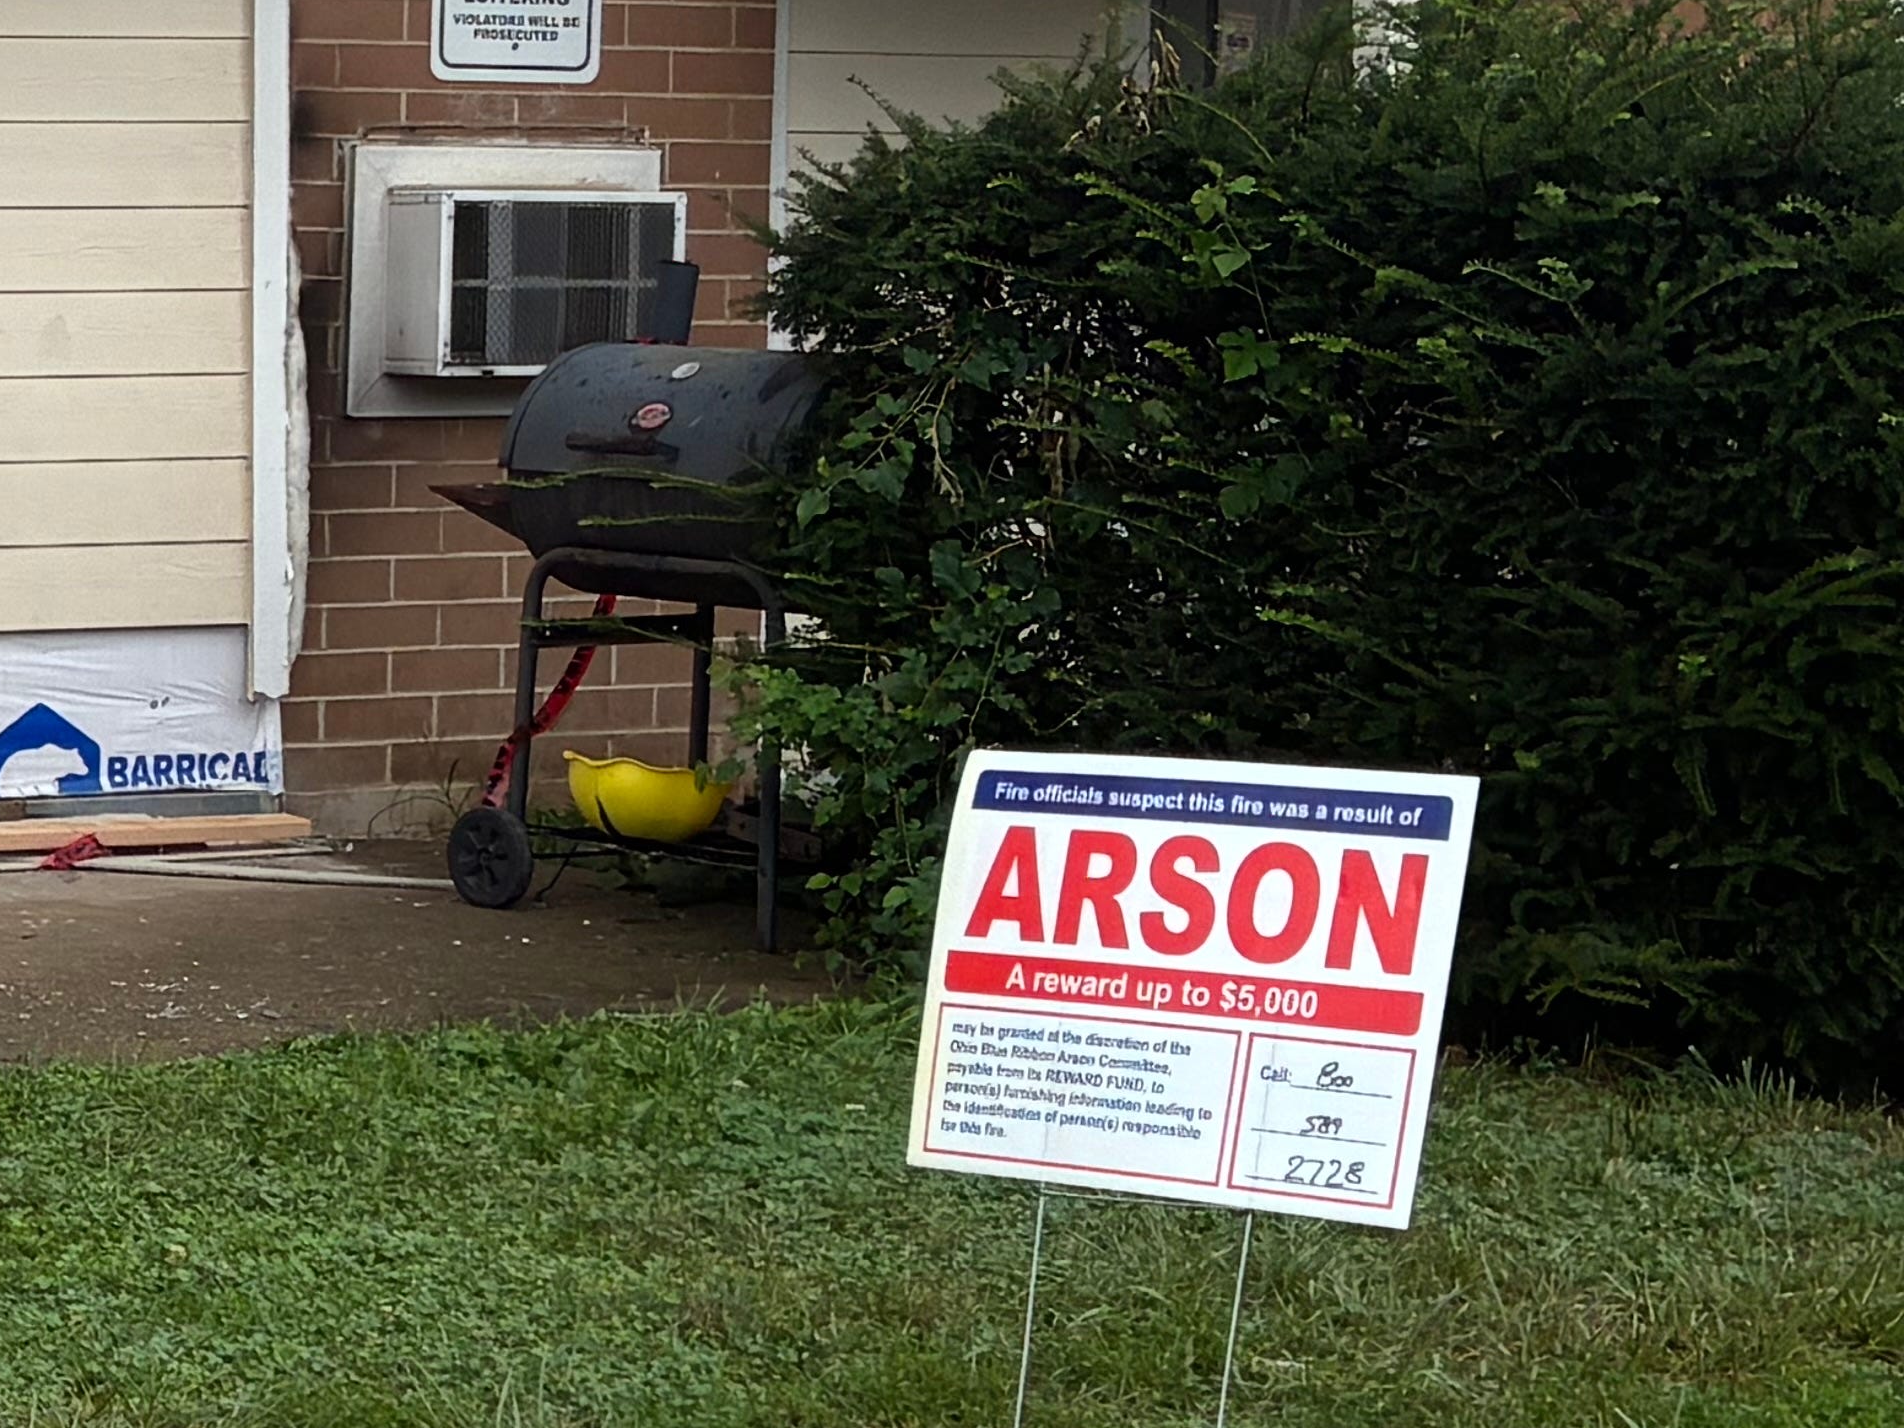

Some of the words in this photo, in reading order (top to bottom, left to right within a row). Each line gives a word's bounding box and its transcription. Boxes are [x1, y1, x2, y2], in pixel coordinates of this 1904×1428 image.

[995, 782, 1030, 801] Fire
[1033, 784, 1103, 805] officials
[1108, 792, 1184, 812] suspect
[1188, 792, 1225, 812] this
[1231, 794, 1264, 816] fire
[1269, 802, 1309, 819] was
[1315, 805, 1328, 820] a
[1333, 805, 1393, 825] result
[1399, 807, 1423, 827] of
[964, 825, 1430, 975] ARSON
[1005, 962, 1026, 990] A
[1033, 972, 1129, 999] reward
[1136, 983, 1173, 1010] up
[1182, 979, 1211, 1007] to
[1219, 980, 1319, 1019] $5,000
[1152, 1038, 1167, 1053] of
[1045, 1068, 1103, 1087] REWARD
[1151, 1081, 1165, 1094] to
[1316, 1061, 1354, 1087] 800
[1044, 1109, 1058, 1123] of
[1197, 1107, 1213, 1120] to
[1284, 1155, 1365, 1189] 2728
